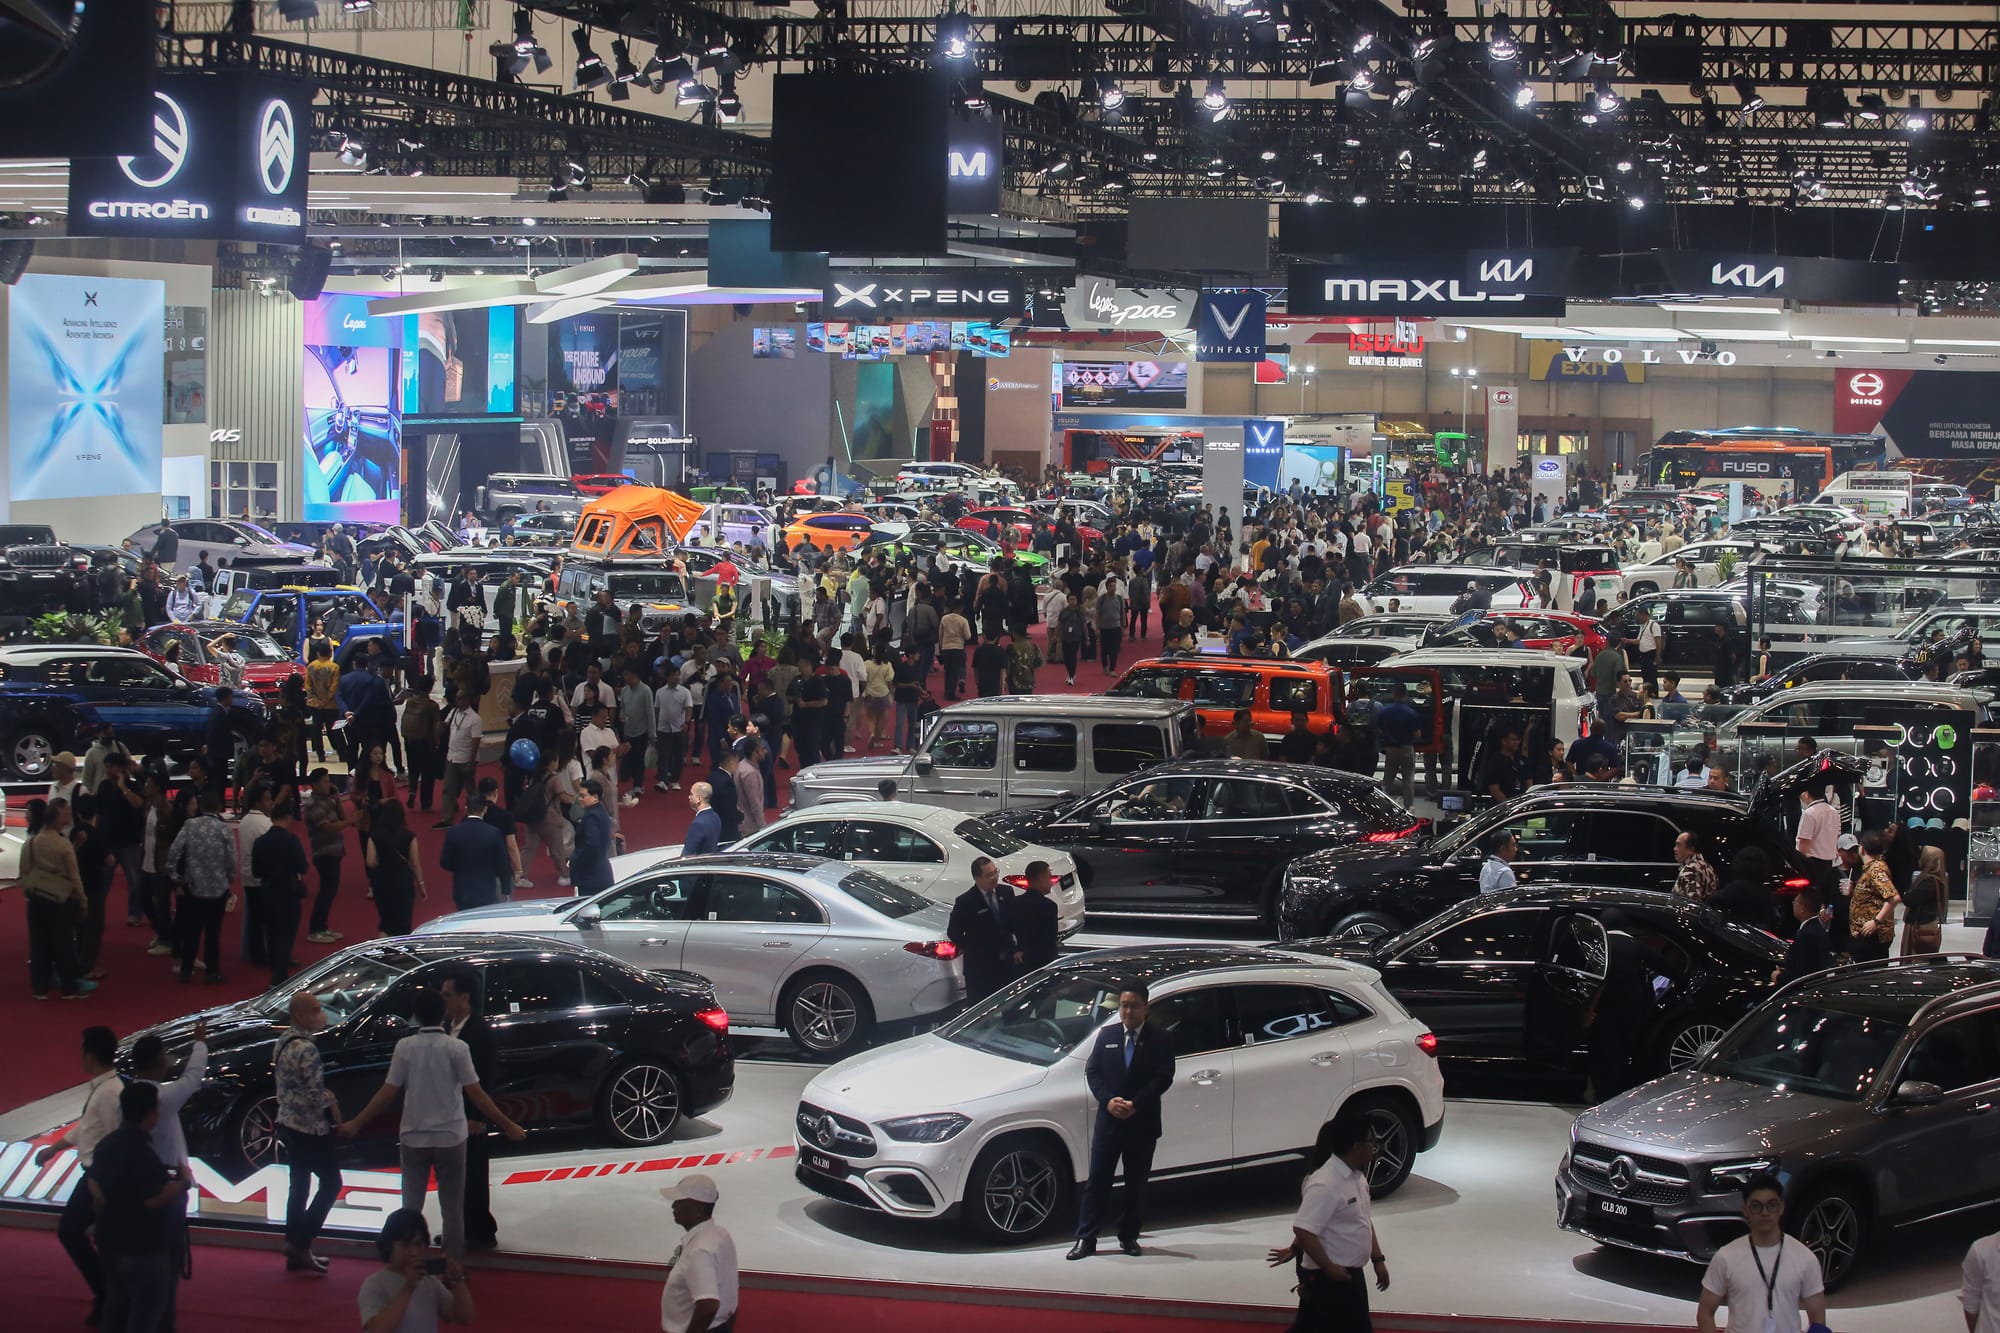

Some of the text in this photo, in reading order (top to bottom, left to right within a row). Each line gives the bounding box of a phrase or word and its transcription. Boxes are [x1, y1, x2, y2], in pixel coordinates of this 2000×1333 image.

[1480, 259, 1533, 282] KIA
[1712, 262, 1784, 289] KIA
[883, 289, 1008, 304] XPENG
[1325, 279, 1526, 301] MAXU
[1112, 304, 1177, 325] pas
[1201, 346, 1260, 354] VINFAST
[1562, 348, 1736, 366] VOLVO
[573, 351, 600, 367] FUTURE
[1561, 361, 1612, 376] EXIT
[573, 368, 606, 385] UNBOUND
[1850, 398, 1882, 406] HINO
[1943, 422, 1961, 430] UNTUK
[1929, 430, 1968, 439] BERSAMA
[1951, 440, 1975, 449] MASA
[1722, 462, 1770, 473] FUSO
[813, 1155, 830, 1169] GLA 200
[1601, 1201, 1628, 1216] GLB 200
